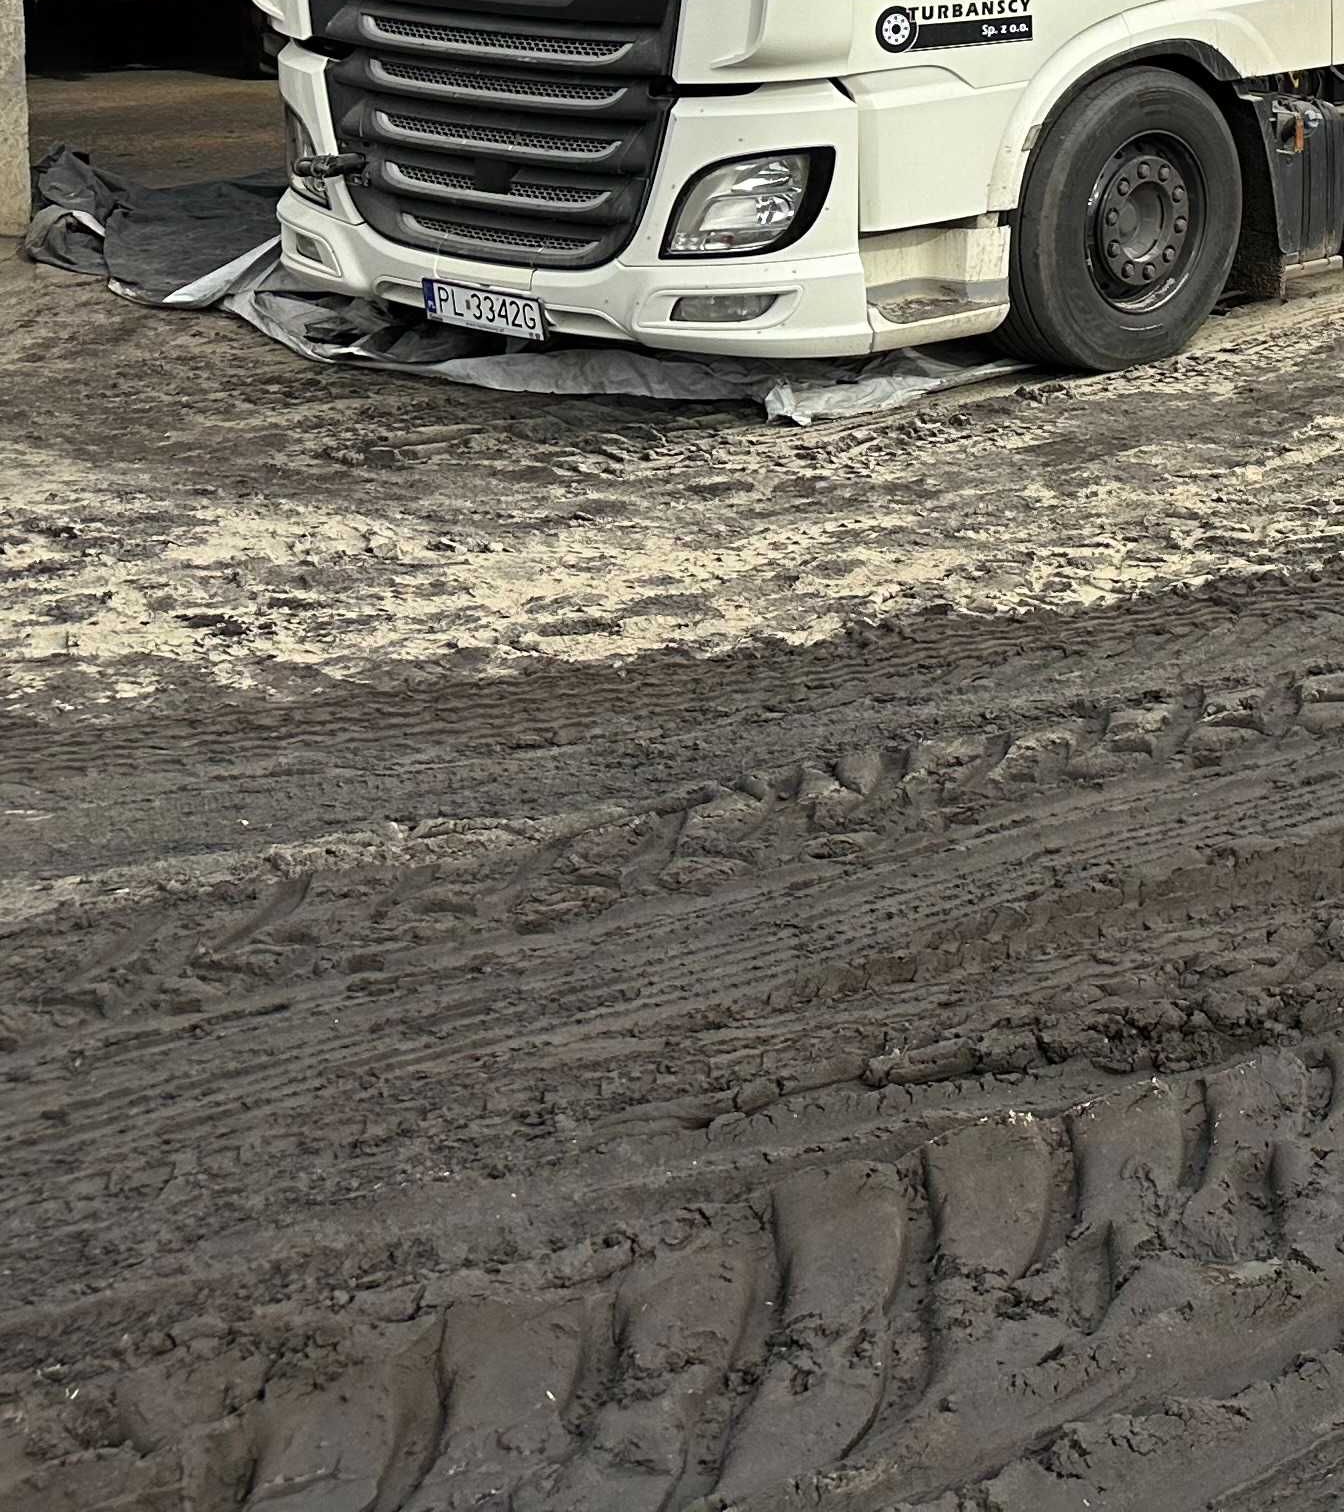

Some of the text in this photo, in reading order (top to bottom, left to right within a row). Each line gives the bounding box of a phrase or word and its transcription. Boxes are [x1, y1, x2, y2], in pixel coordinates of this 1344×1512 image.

[981, 23, 1029, 38] Sp. z o.o.
[437, 286, 537, 329] PL 3342G
